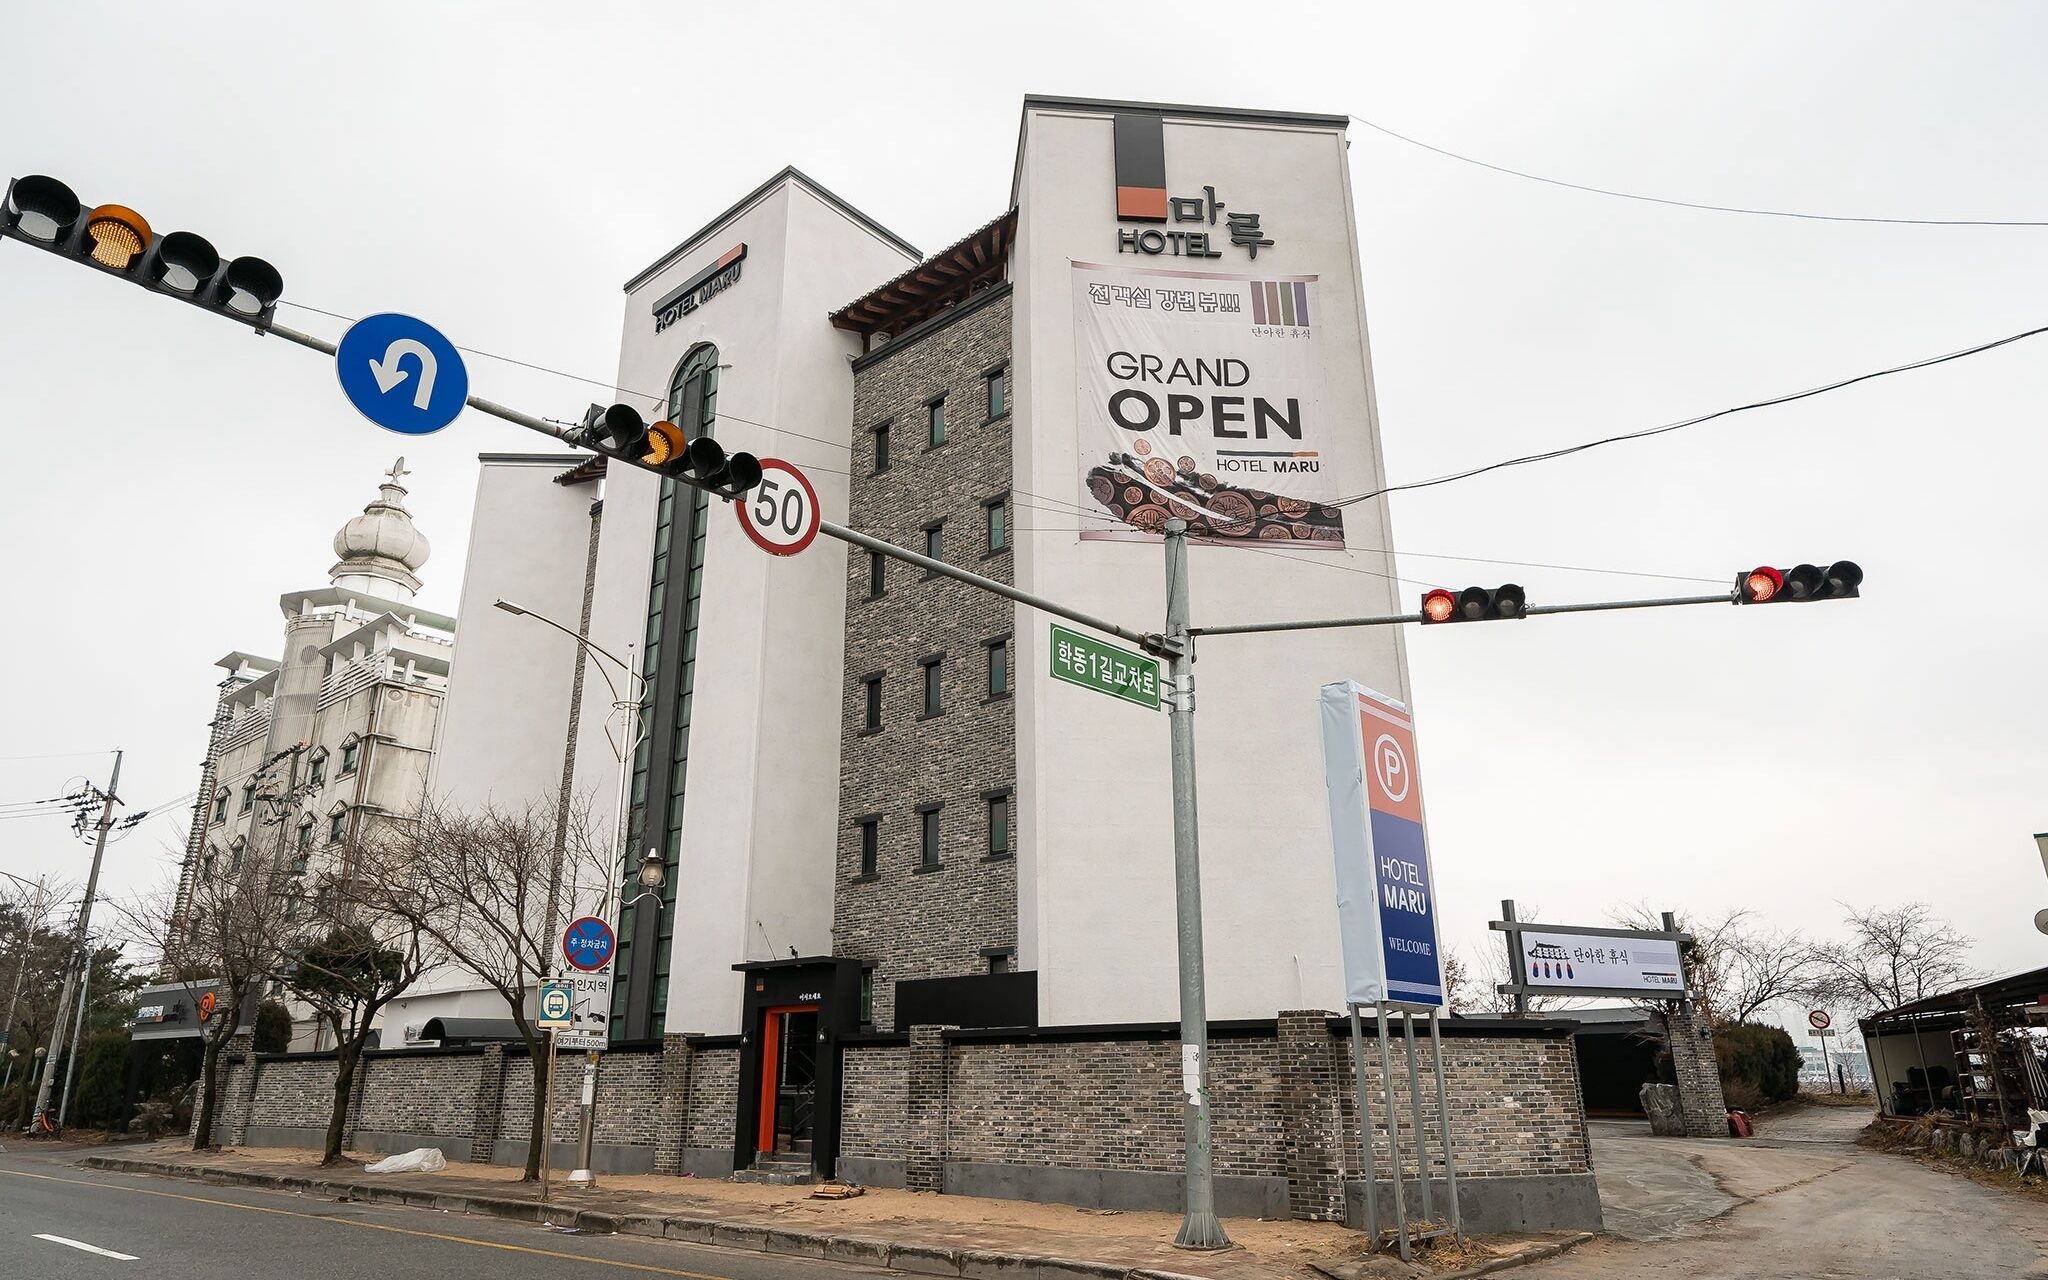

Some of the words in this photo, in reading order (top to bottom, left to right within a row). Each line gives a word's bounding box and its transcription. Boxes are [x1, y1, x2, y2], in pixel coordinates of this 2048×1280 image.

[1169, 185, 1275, 260] 마루
[1118, 228, 1222, 258] HOTEL
[655, 293, 699, 335] HOTEL
[699, 262, 742, 305] MARU
[1251, 326, 1285, 339] 단아한
[1106, 351, 1250, 387] GRAND
[1108, 389, 1302, 440] OPEN
[1216, 458, 1268, 473] HOTEL
[1273, 460, 1320, 474] MARU
[754, 478, 804, 536] 50
[1057, 640, 1156, 696] 학동1길교차로
[1383, 747, 1401, 787] P
[1381, 855, 1424, 887] HOTEL
[1384, 885, 1427, 916] MARU
[1388, 936, 1432, 957] WELCOME
[1573, 946, 1606, 964] 단아한
[1608, 948, 1629, 966] 휴식
[1643, 975, 1660, 984] HOTEL
[1662, 977, 1678, 985] MARU
